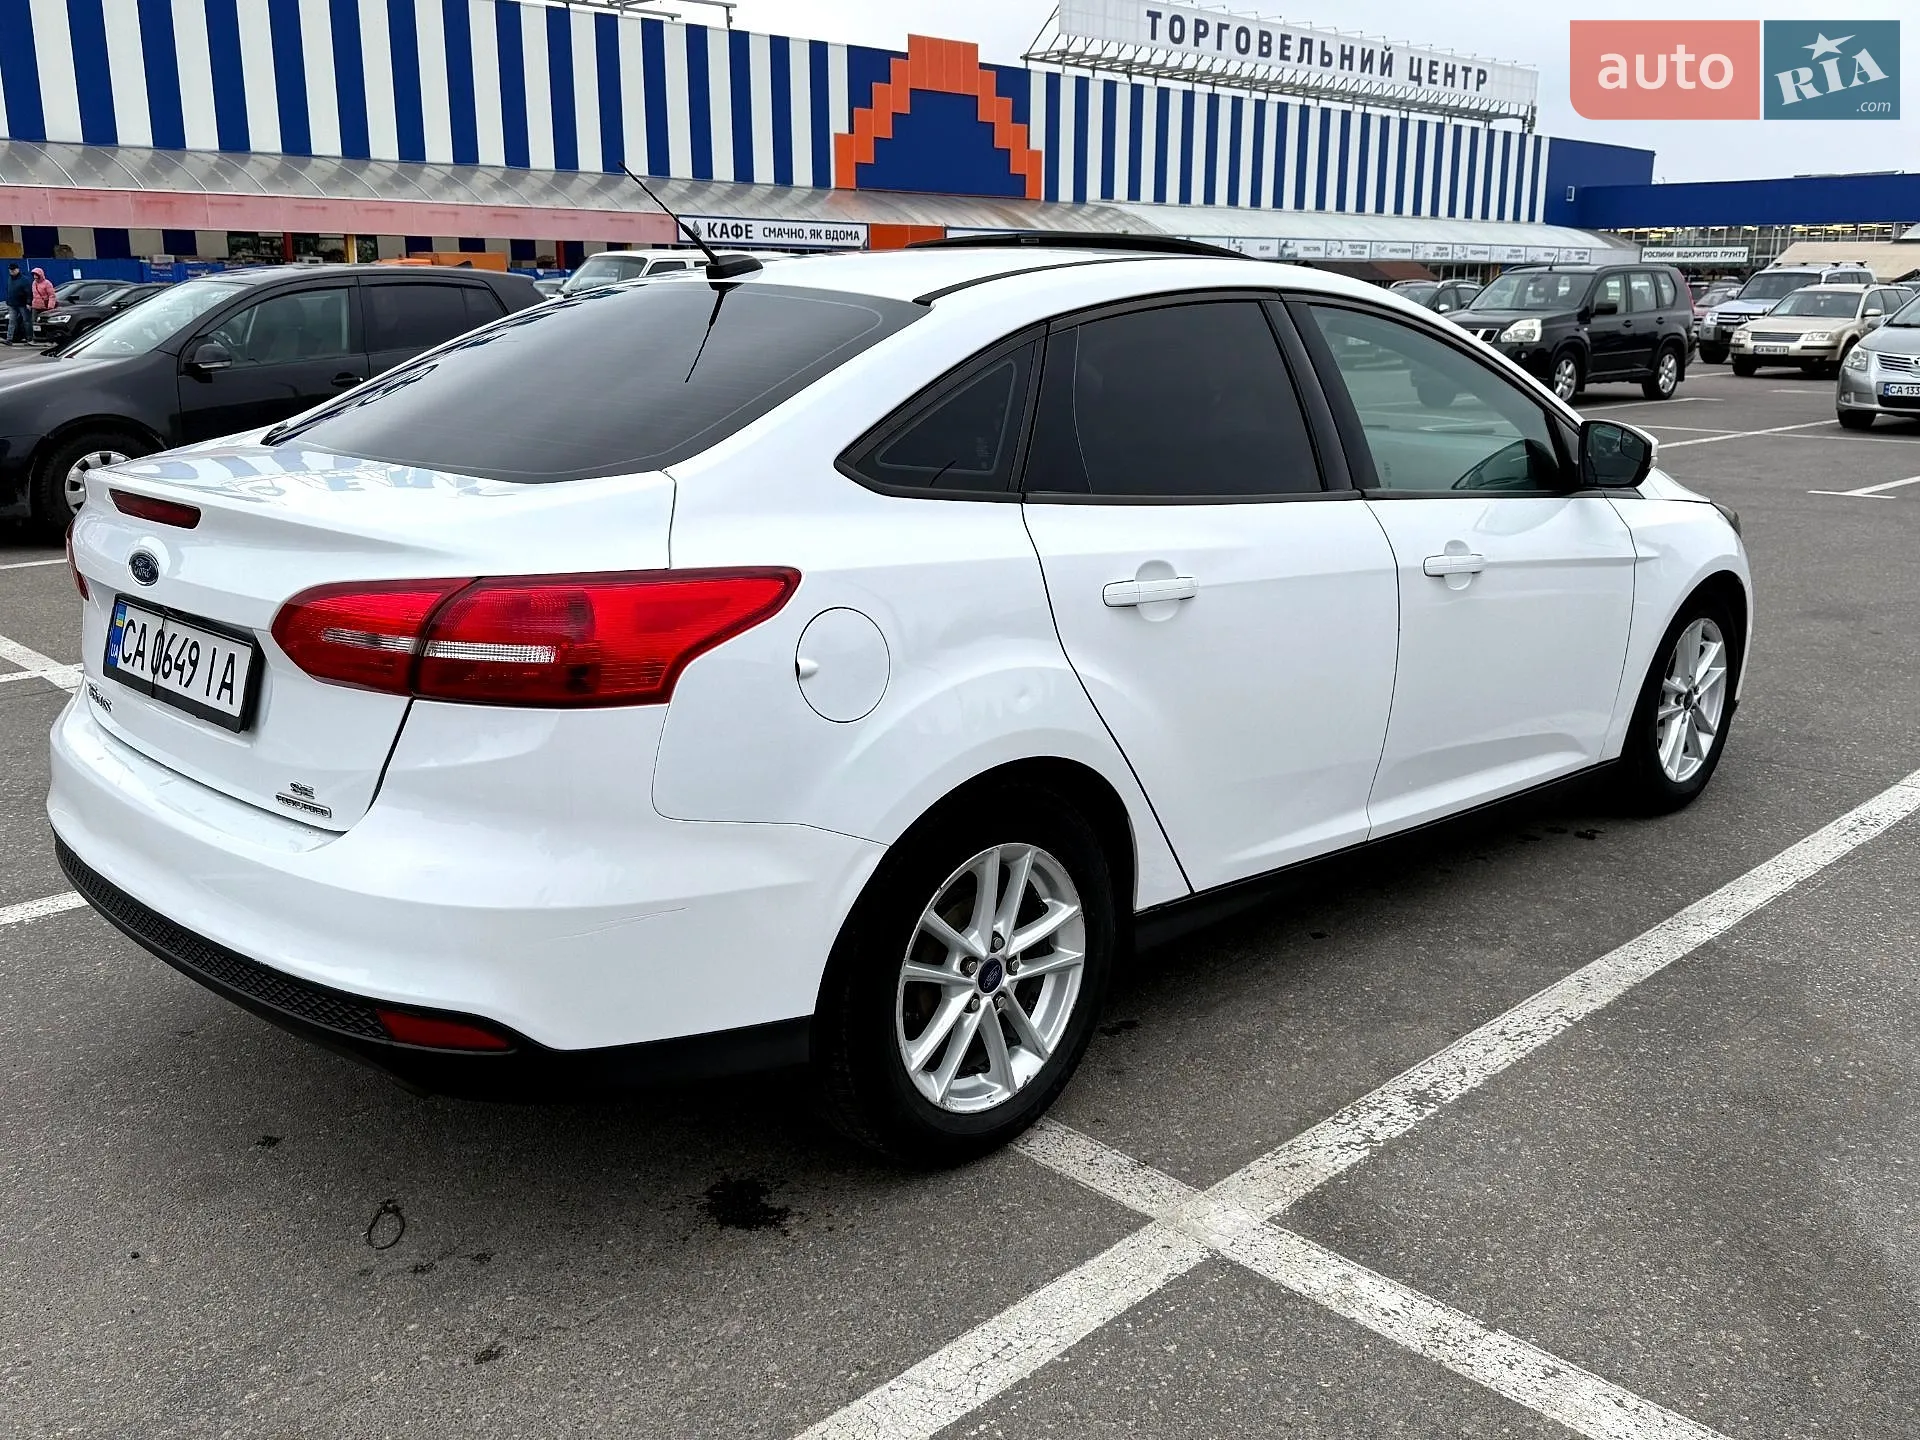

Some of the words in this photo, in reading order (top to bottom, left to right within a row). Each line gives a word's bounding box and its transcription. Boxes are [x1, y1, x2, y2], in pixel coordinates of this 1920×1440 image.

[1146, 10, 1394, 78] ТОРГОВЕЛЬНИЙ
[1408, 57, 1488, 92] ЦЕНТР
[707, 222, 754, 239] КАФЕ
[762, 226, 808, 240] СМАЧНО,
[809, 229, 823, 240] ЯК
[825, 229, 860, 242] ВДОМА
[1890, 385, 1903, 395] CA
[121, 618, 148, 671] CA
[150, 628, 201, 688] 0649
[205, 647, 236, 706] IA
